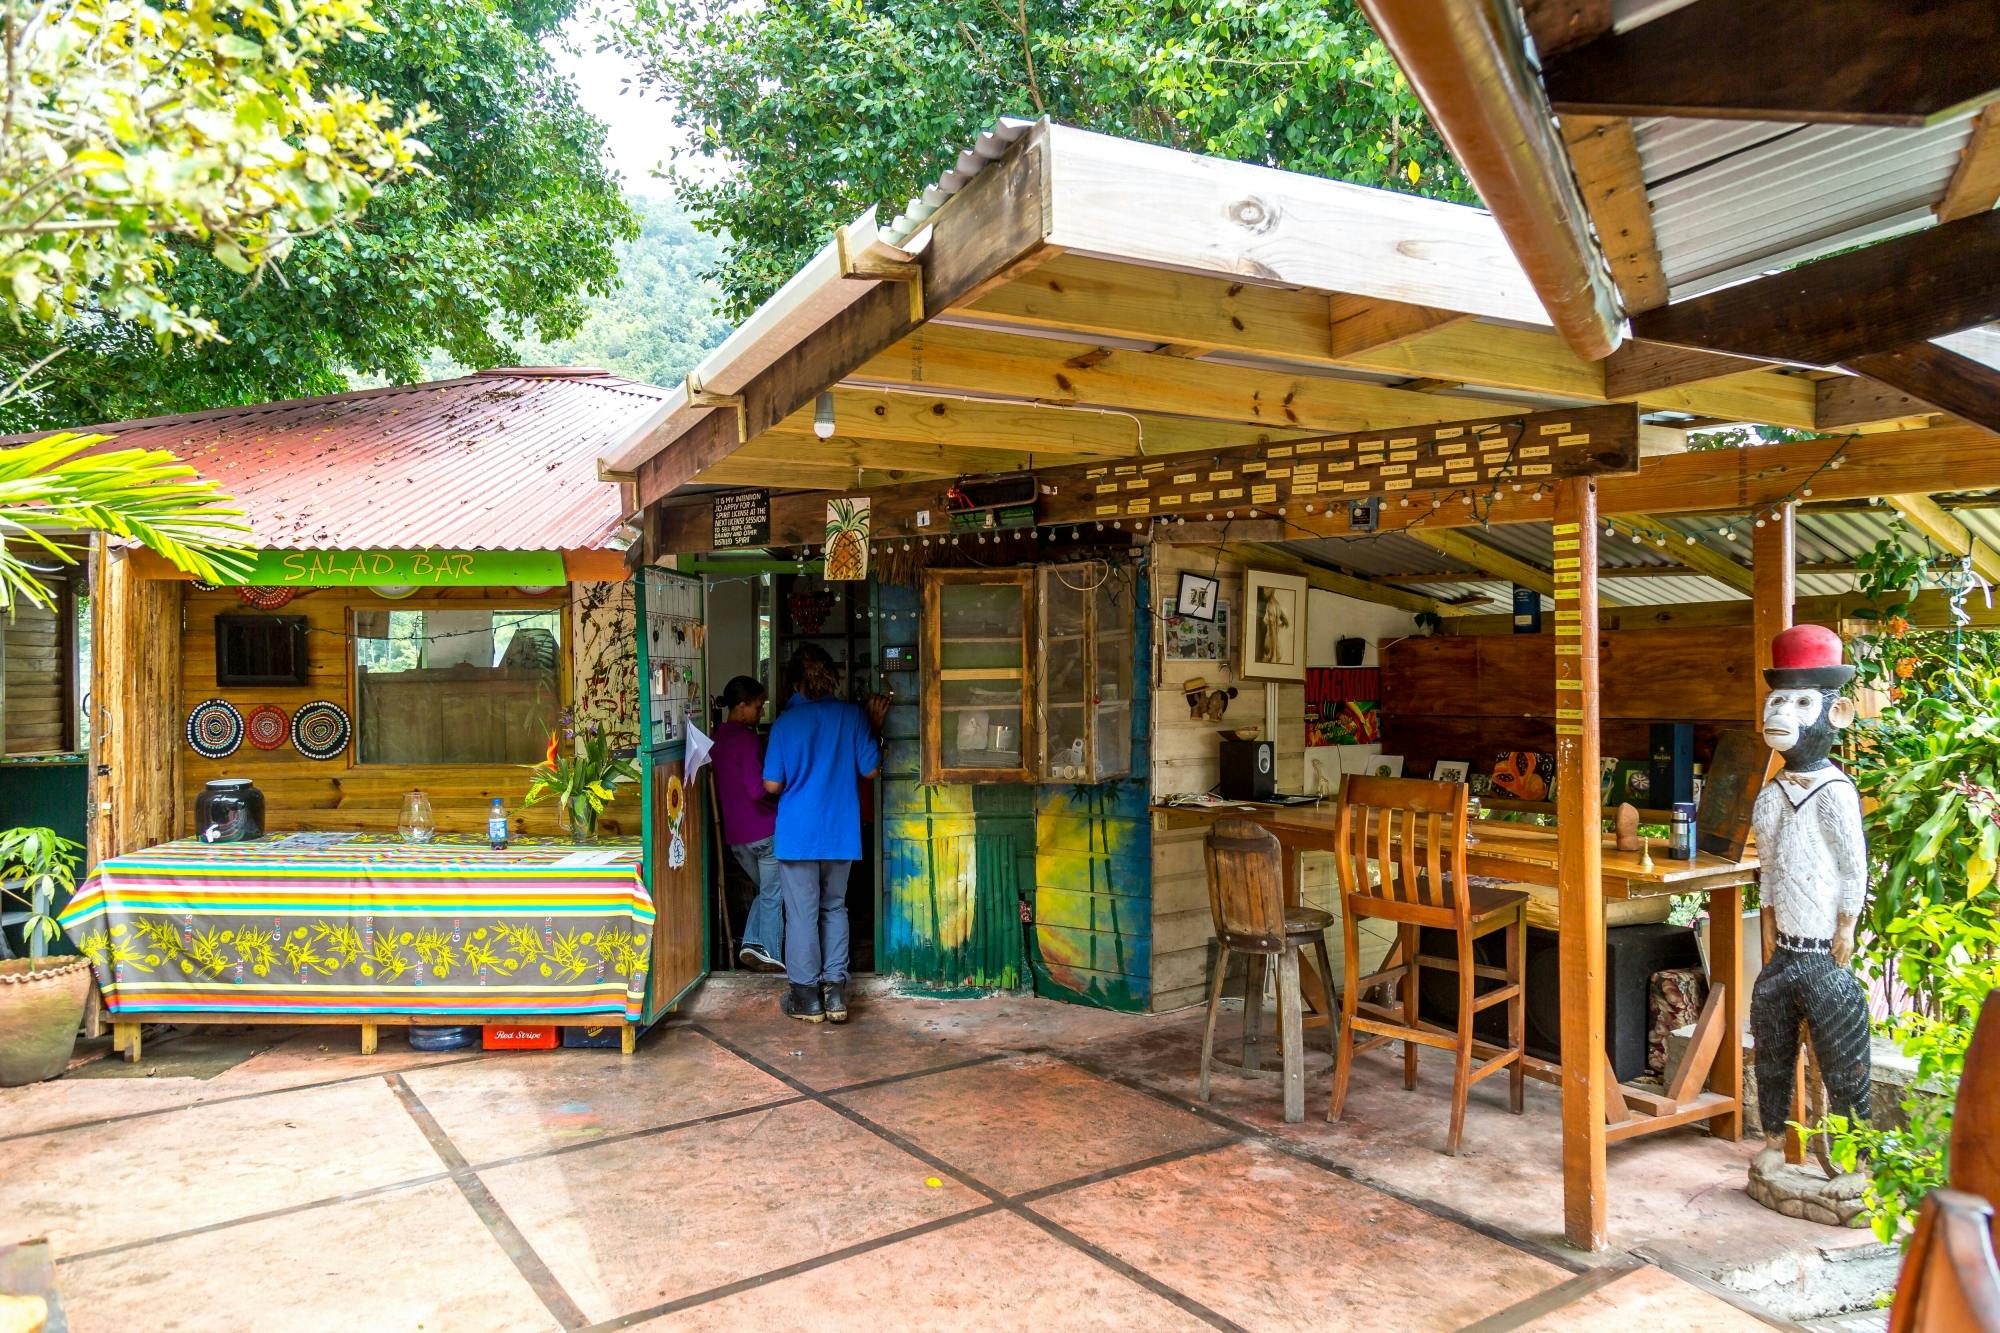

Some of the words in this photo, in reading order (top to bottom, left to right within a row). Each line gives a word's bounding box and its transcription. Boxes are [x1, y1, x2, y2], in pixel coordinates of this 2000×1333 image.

[725, 496, 735, 504] MY
[735, 493, 761, 502] INTENTION
[723, 502, 740, 511] APPLY
[740, 501, 750, 510] FOR
[715, 511, 731, 520] SPIRIT
[731, 509, 749, 518] LICENSE
[749, 508, 756, 516] AT
[756, 507, 766, 515] THE
[714, 519, 728, 527] NEXT
[728, 517, 745, 526] LICENSE
[745, 515, 767, 524] SESSION
[734, 536, 750, 544] SPIRIT
[283, 553, 394, 583] SALAD
[410, 553, 474, 582] BAR
[1305, 668, 1380, 703] MAGNUM
[545, 916, 553, 946] OLIVES
[495, 1031, 514, 1040] Red
[515, 1031, 542, 1040] Stripe
